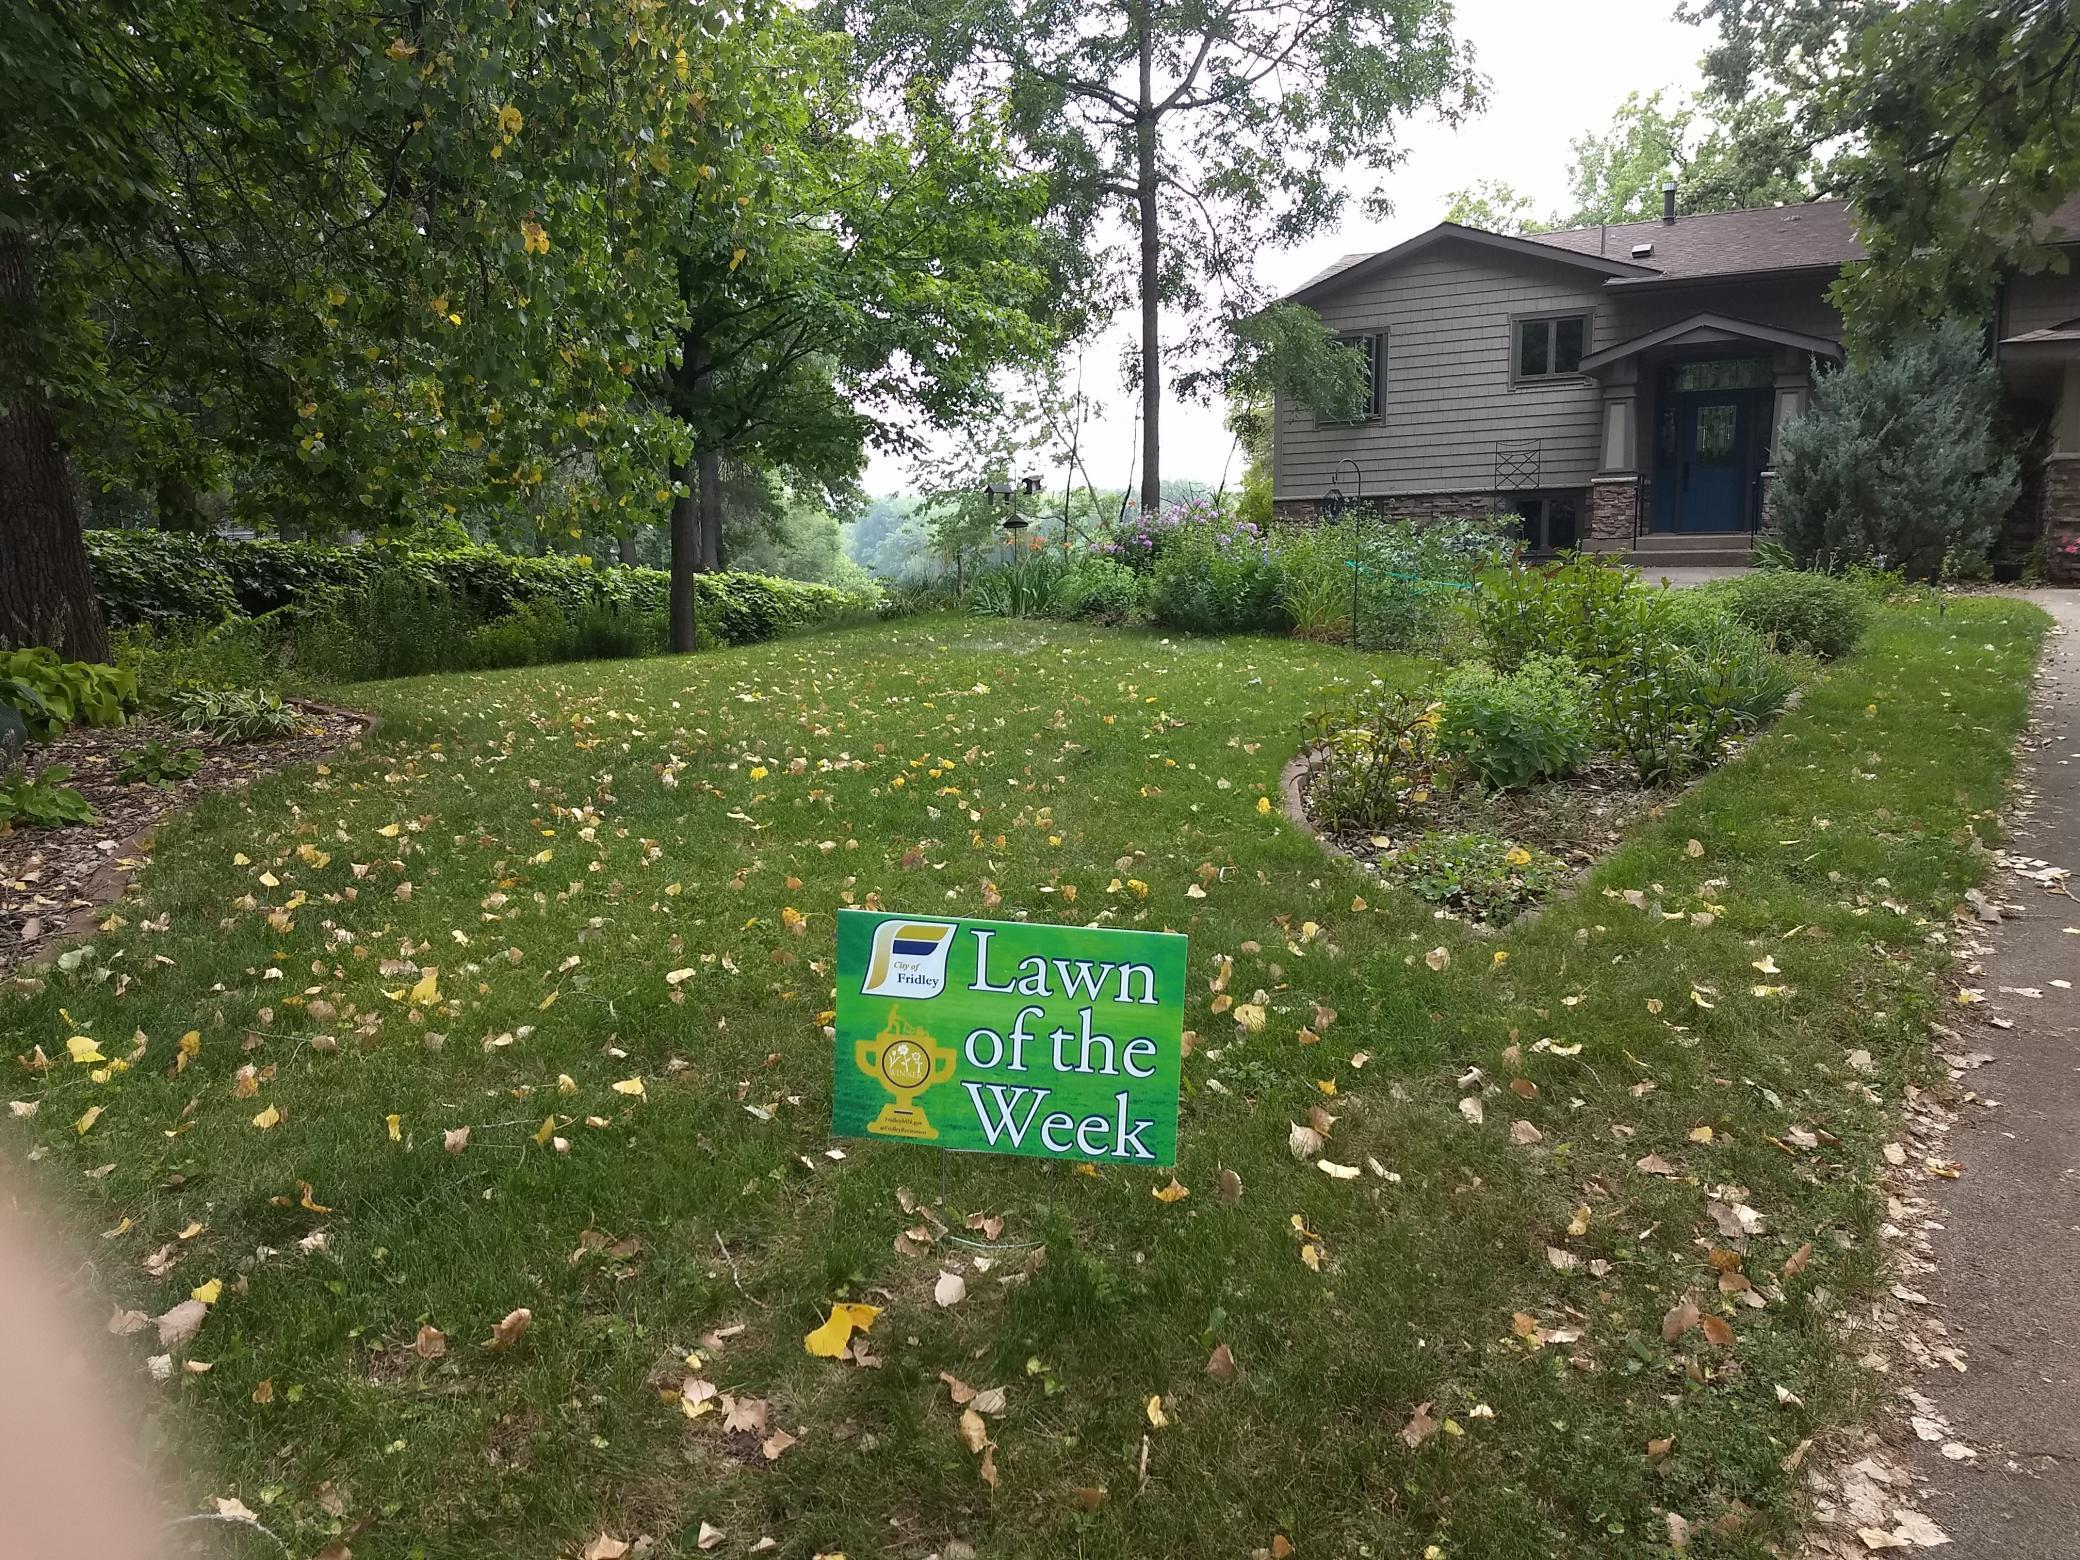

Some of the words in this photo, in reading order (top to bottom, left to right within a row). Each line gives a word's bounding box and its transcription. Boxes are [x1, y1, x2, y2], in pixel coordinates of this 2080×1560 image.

[893, 961, 910, 970] City
[911, 963, 920, 971] of
[897, 973, 939, 988] Fridley
[968, 928, 1159, 1004] Lawn
[963, 1005, 1045, 1071] of
[1049, 1006, 1158, 1079] the
[888, 1069, 923, 1079] WINNER
[961, 1080, 1156, 1159] Week
